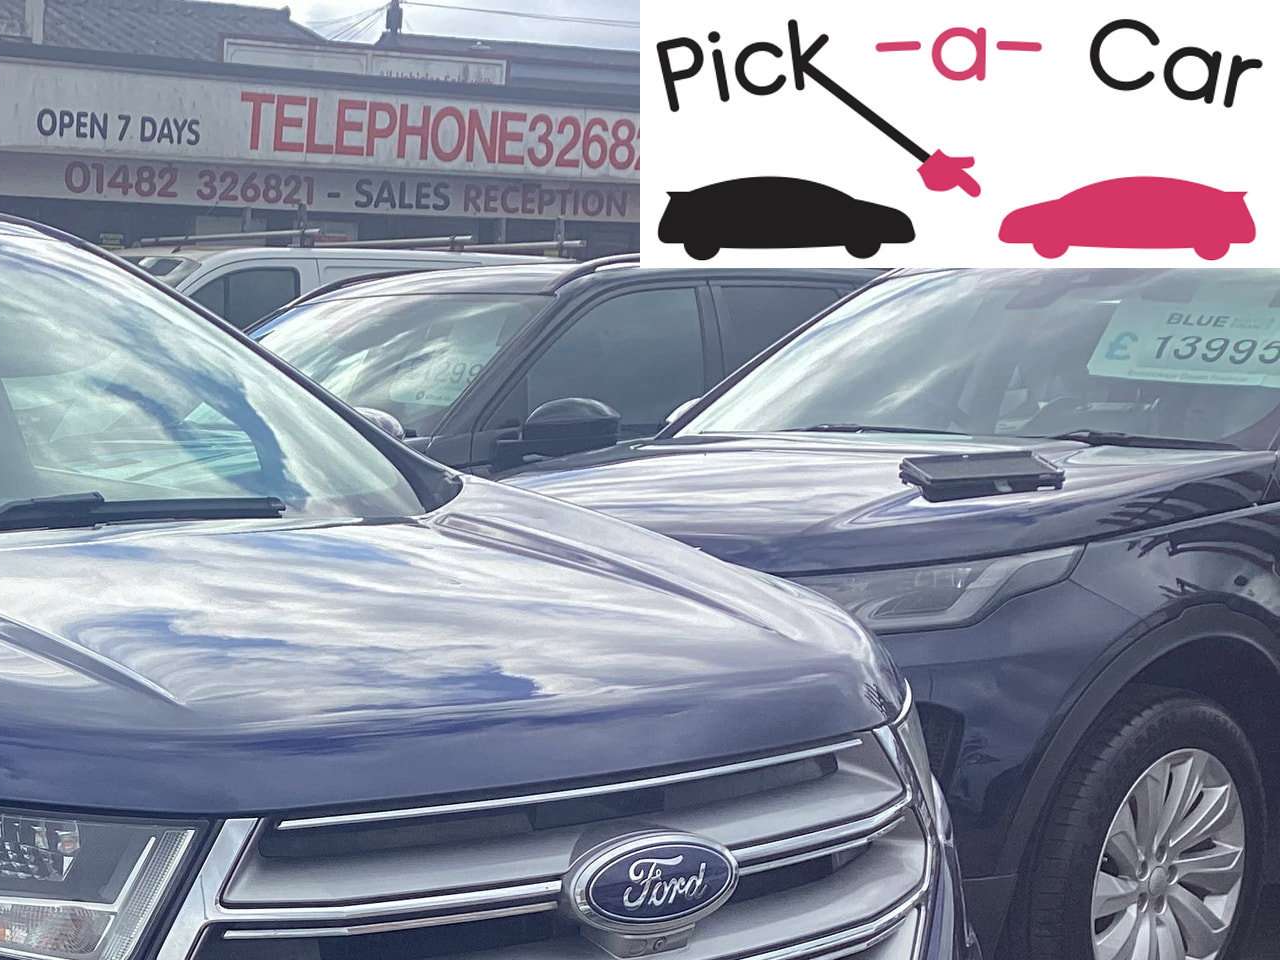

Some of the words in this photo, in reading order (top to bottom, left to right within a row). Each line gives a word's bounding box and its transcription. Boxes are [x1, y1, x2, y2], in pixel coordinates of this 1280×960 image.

[36, 108, 109, 140] OPEN
[117, 114, 132, 142] 7
[140, 116, 201, 146] DAYS
[64, 160, 179, 199] 01482
[196, 169, 315, 206] 326821
[354, 178, 451, 212] SALES
[463, 183, 628, 217] RECEPTION
[1167, 312, 1230, 328] BLUE
[1154, 335, 1280, 365] 13995
[623, 855, 707, 909] Ford
